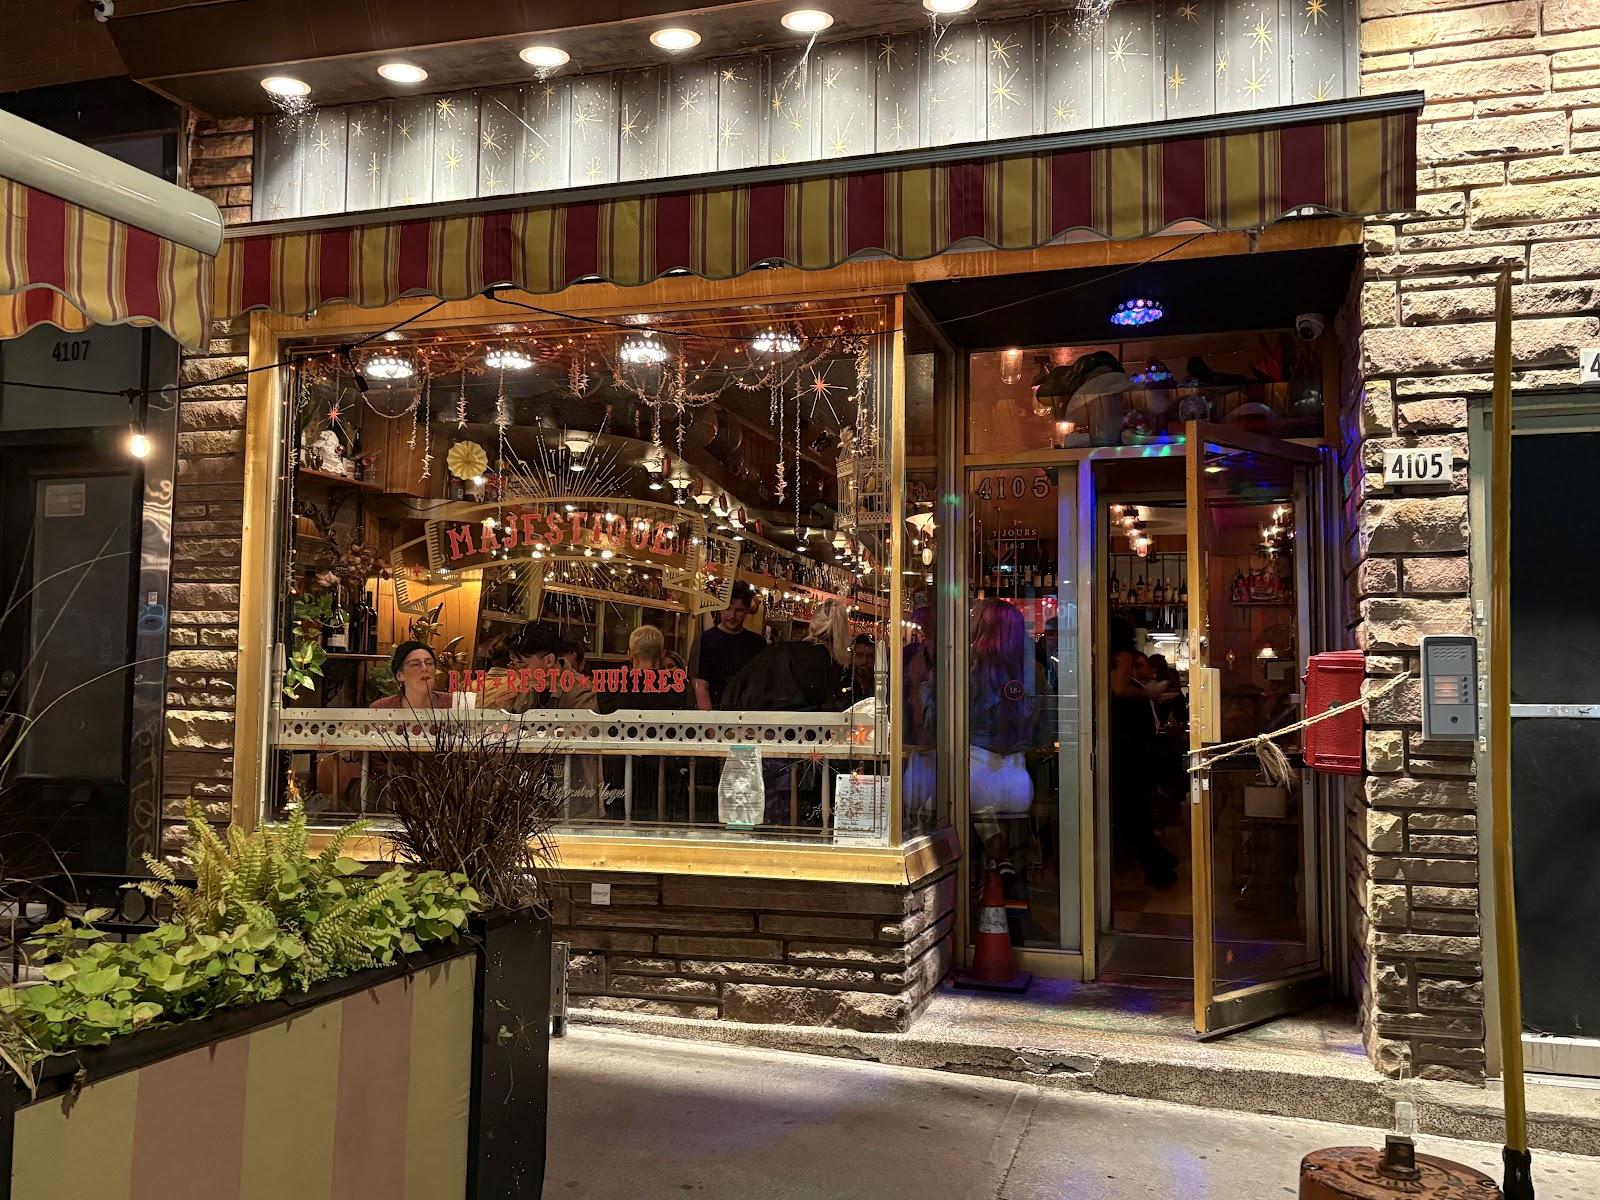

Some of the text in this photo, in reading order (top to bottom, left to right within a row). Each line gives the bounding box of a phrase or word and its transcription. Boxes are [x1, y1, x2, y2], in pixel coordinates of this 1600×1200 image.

[52, 340, 91, 362] 4107
[1391, 452, 1443, 479] 4105
[977, 475, 1050, 500] 4105
[448, 511, 677, 561] MAJESTIQUE
[1001, 528, 1037, 537] JOURS
[449, 665, 688, 694] BAR RESTO HUÎTRES
